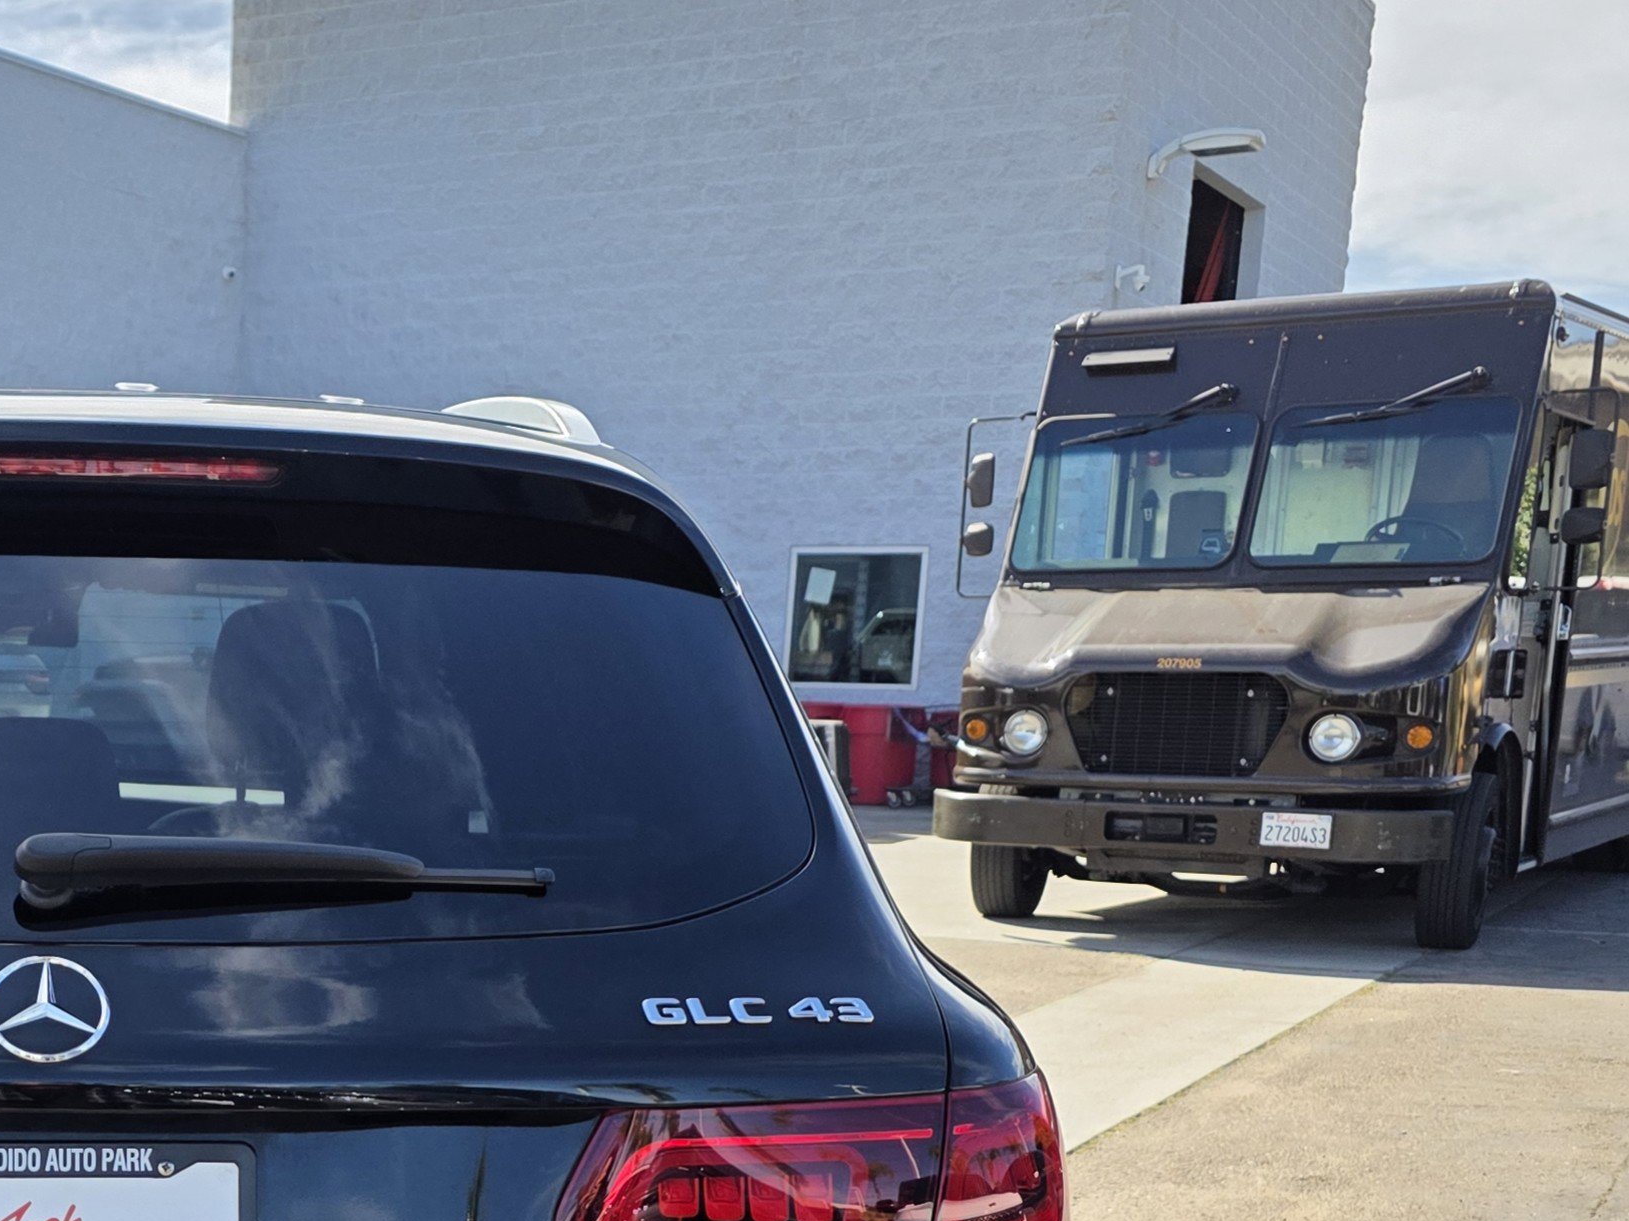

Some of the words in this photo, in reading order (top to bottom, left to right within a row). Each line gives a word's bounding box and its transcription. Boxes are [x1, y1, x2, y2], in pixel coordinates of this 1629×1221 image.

[1156, 657, 1202, 669] 207905
[641, 998, 772, 1025] GLC
[788, 997, 874, 1023] 43
[45, 1147, 96, 1173] AUTO
[101, 1147, 153, 1173] PARK
